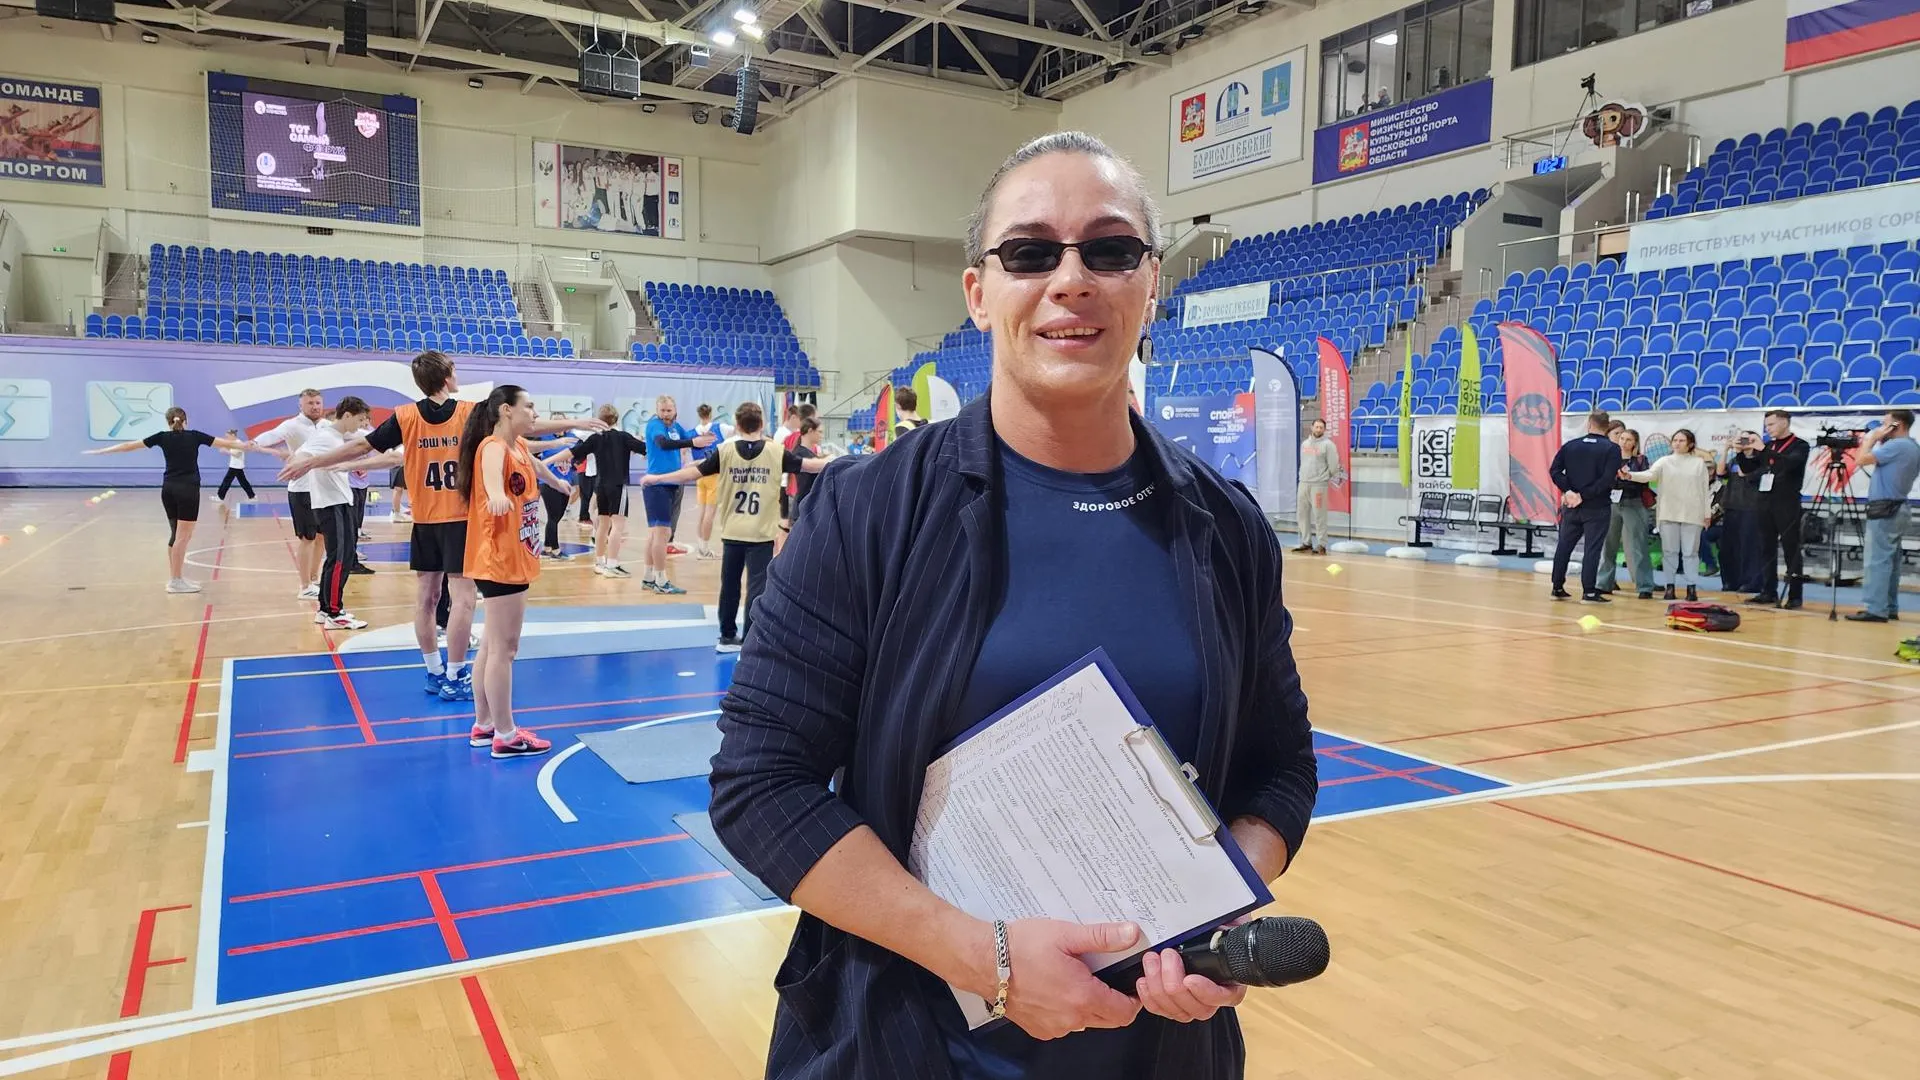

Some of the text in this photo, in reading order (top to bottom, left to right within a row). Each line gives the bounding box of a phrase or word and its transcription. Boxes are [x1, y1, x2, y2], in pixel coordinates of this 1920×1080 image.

[1, 82, 84, 103] ОМАНДЕ
[1370, 101, 1439, 128] МИНИСТЕРСТВО
[1370, 114, 1428, 136] ФИЗИЧЕСКОЙ
[289, 123, 310, 134] ТОТ
[1369, 128, 1413, 147] КУЛЬТУРЫ
[1422, 115, 1458, 132] СПОРТА
[1193, 131, 1272, 169] БОРИСОГЛЕБСКИЙ
[1369, 133, 1428, 156] МОСКОВСКОЙ
[1369, 148, 1408, 165] ОБЛАСТИ
[0, 161, 87, 180] ПОРТОМ
[1640, 233, 1756, 258] ПРИВЕТСТВУЕМ
[1760, 216, 1873, 242] УЧАСТНИКОВ
[1210, 410, 1236, 420] СПОРТ
[417, 436, 458, 448] СОШ №9
[1213, 435, 1232, 444] СИЛА
[425, 460, 459, 491] 48
[734, 490, 760, 515] 26
[1072, 496, 1136, 512] ЗДОРОВОЕ
